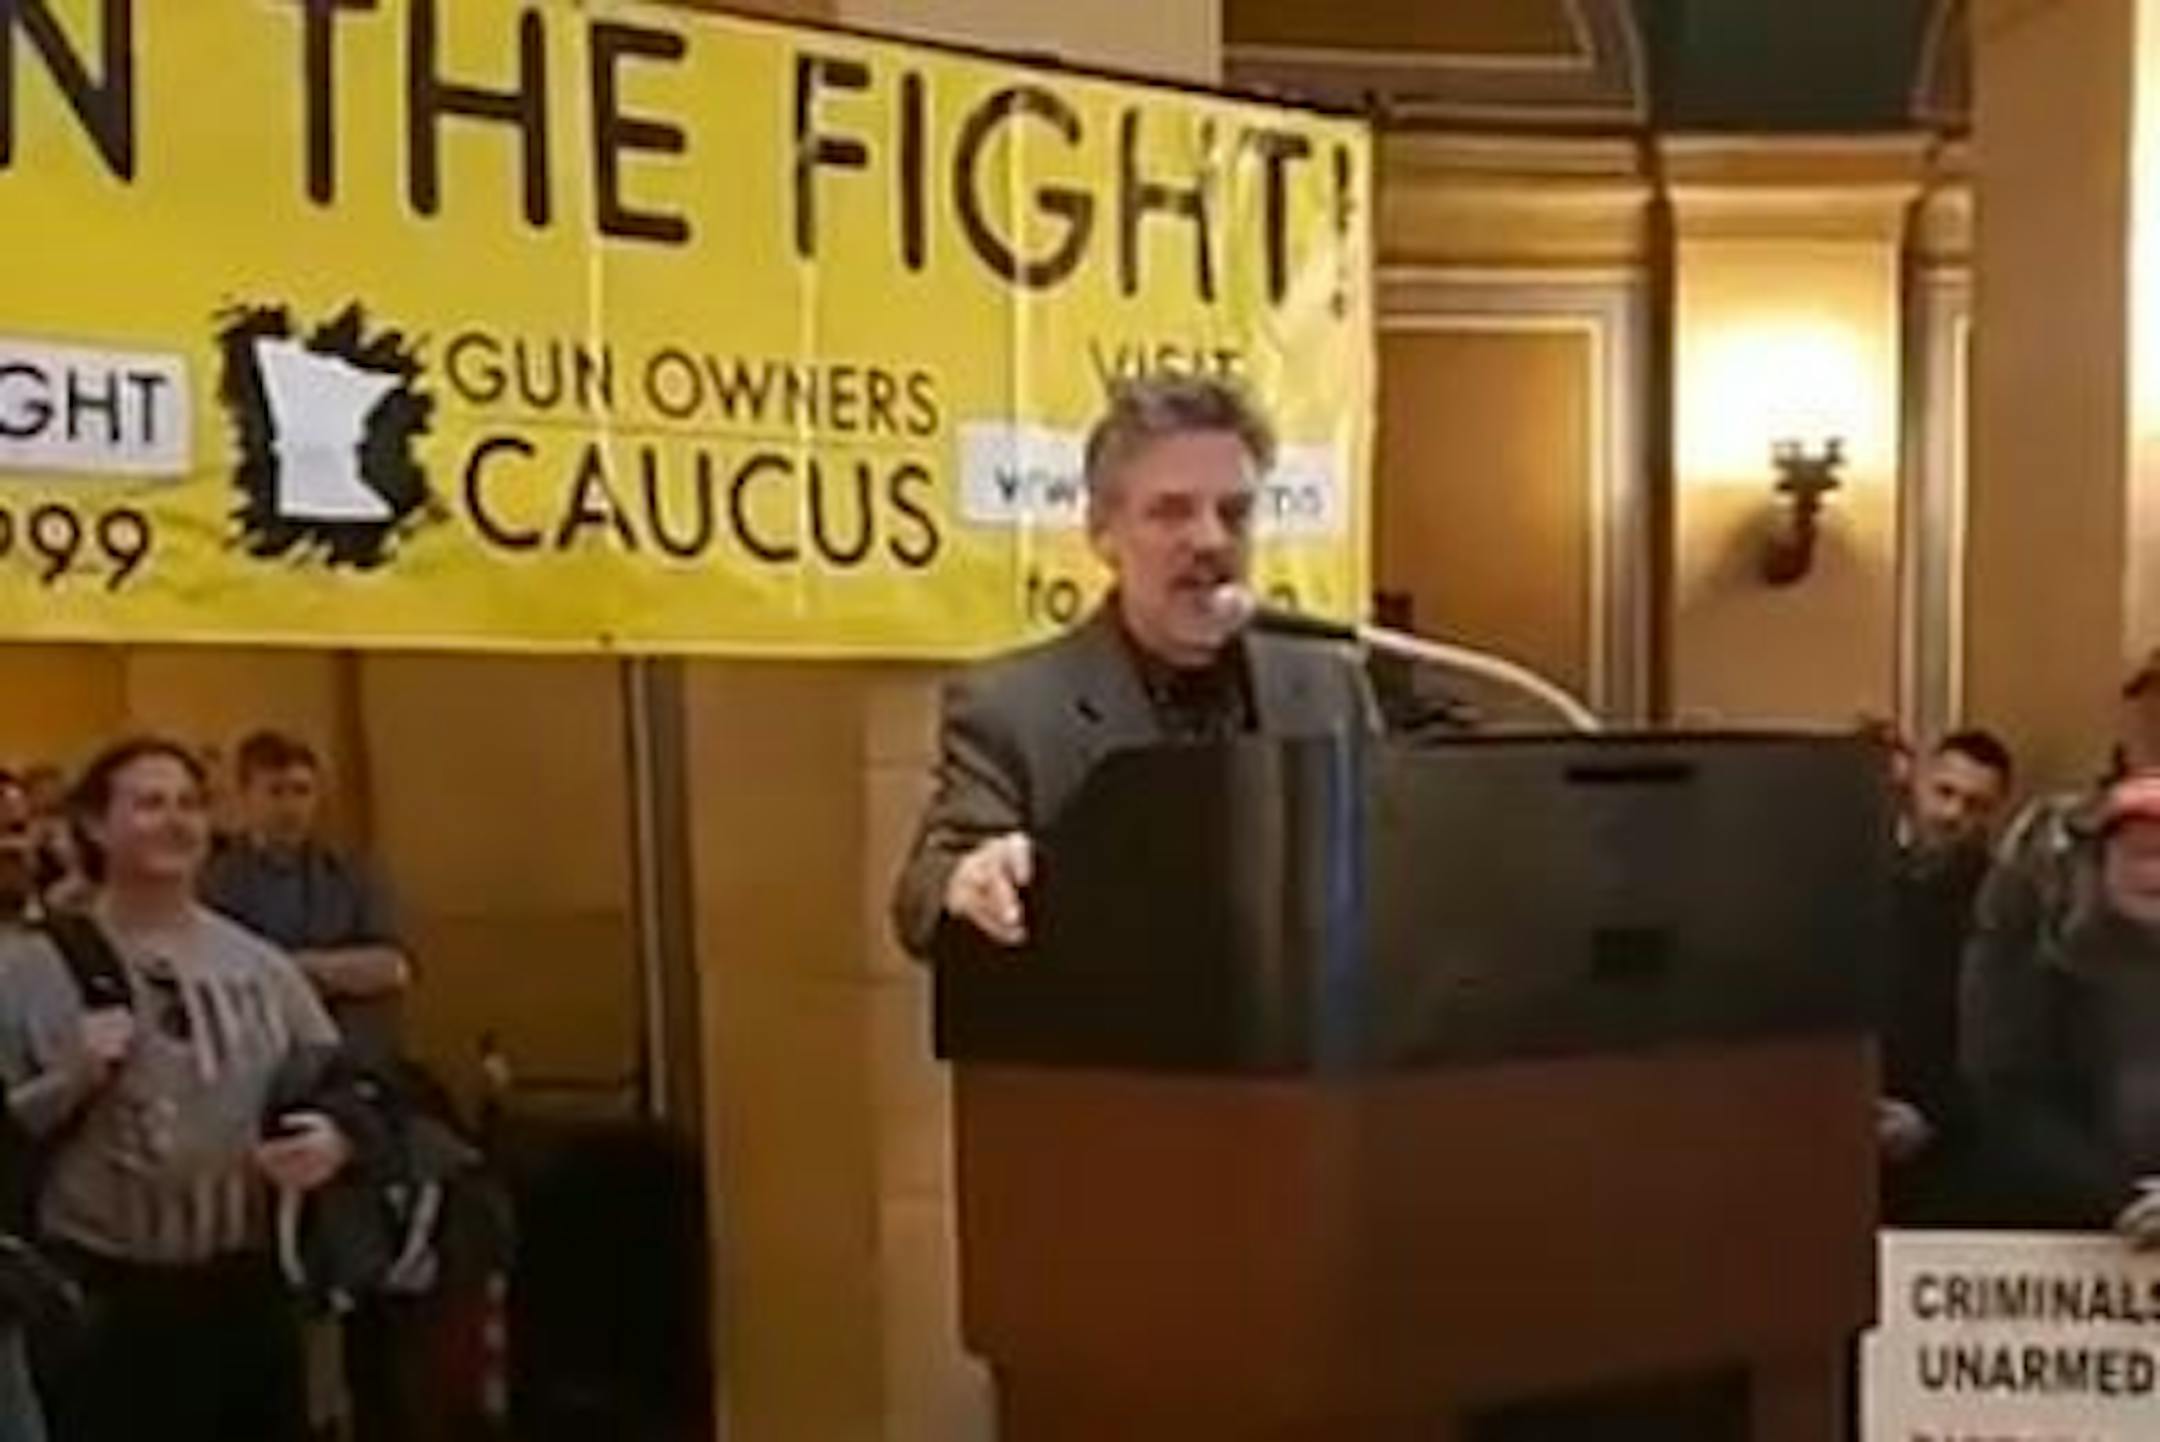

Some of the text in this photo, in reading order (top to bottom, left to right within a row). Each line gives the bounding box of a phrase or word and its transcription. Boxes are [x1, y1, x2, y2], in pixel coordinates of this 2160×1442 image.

[293, 0, 690, 245] THE
[795, 53, 1354, 320] FIGHT!
[0, 365, 167, 443] GHT
[445, 332, 939, 436] GUN OWNERS
[463, 436, 940, 568] CAUCUS
[0, 504, 151, 591] 99
[1024, 571, 1082, 625] to
[1917, 1346, 2154, 1394] UNARMED
